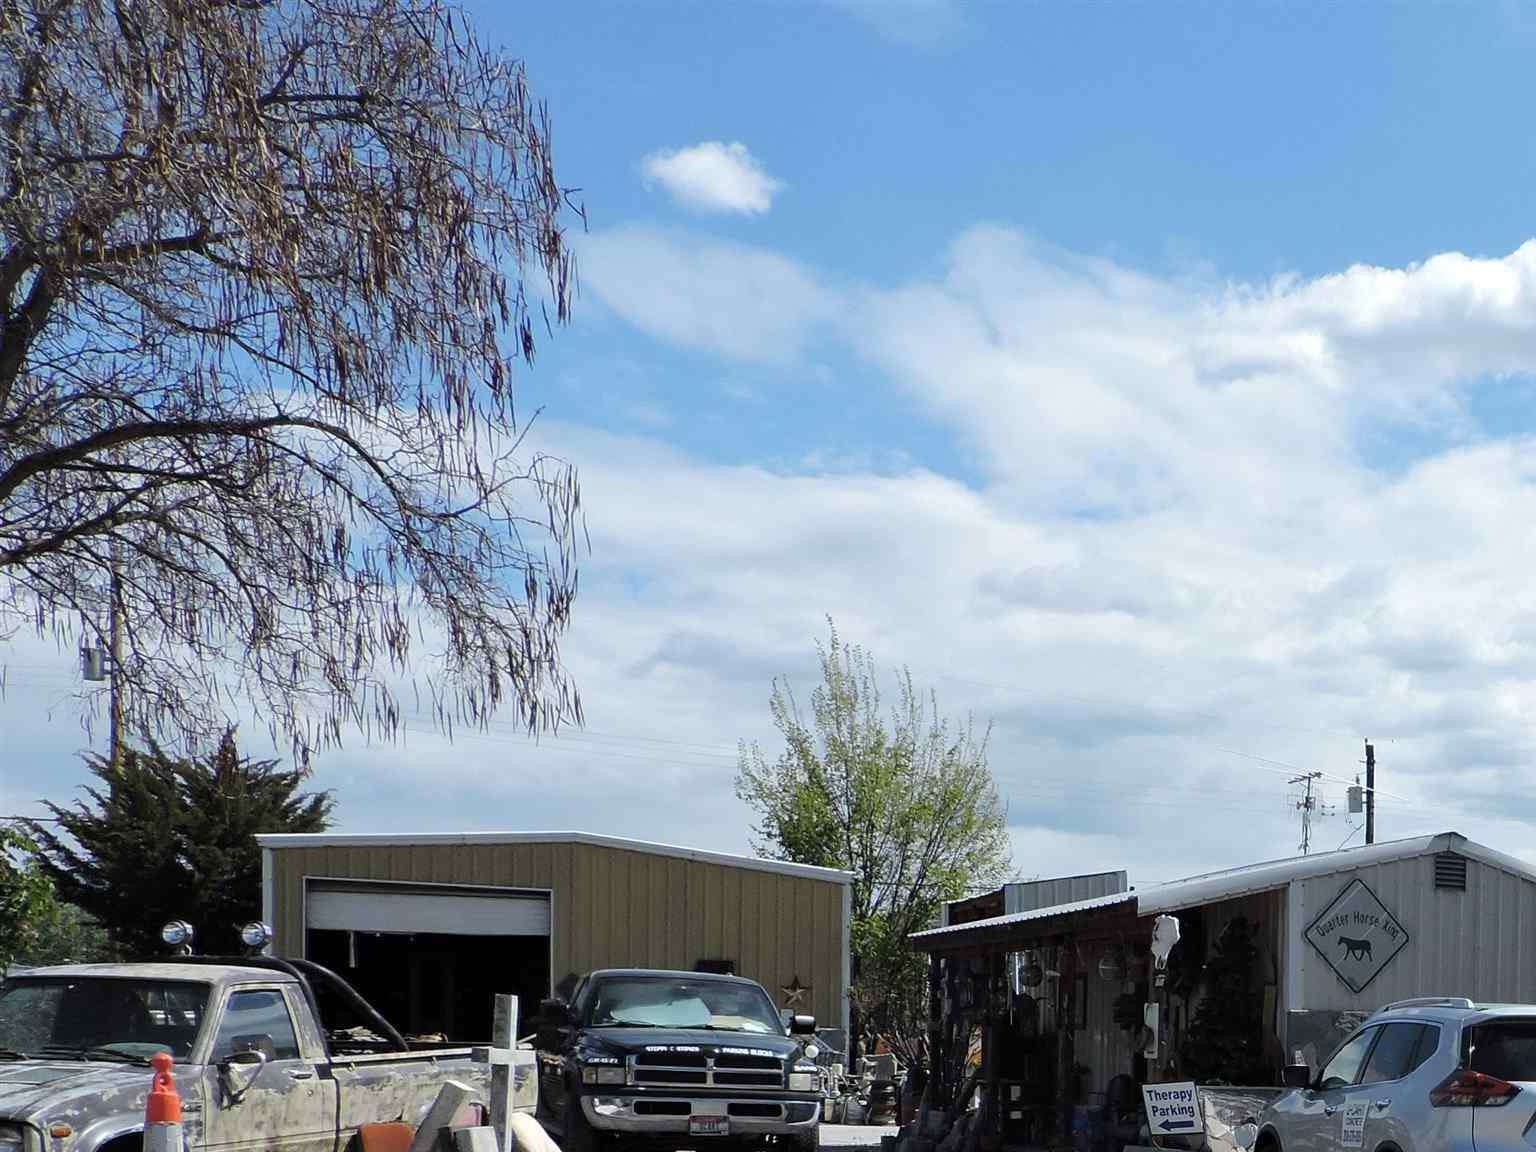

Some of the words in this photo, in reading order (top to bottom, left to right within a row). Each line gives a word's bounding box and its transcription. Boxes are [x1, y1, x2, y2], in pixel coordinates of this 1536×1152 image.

[1316, 914, 1349, 937] Quarter
[1353, 911, 1379, 927] Horse
[1146, 1089, 1193, 1103] Therapy
[1151, 1104, 1195, 1117] Parking
